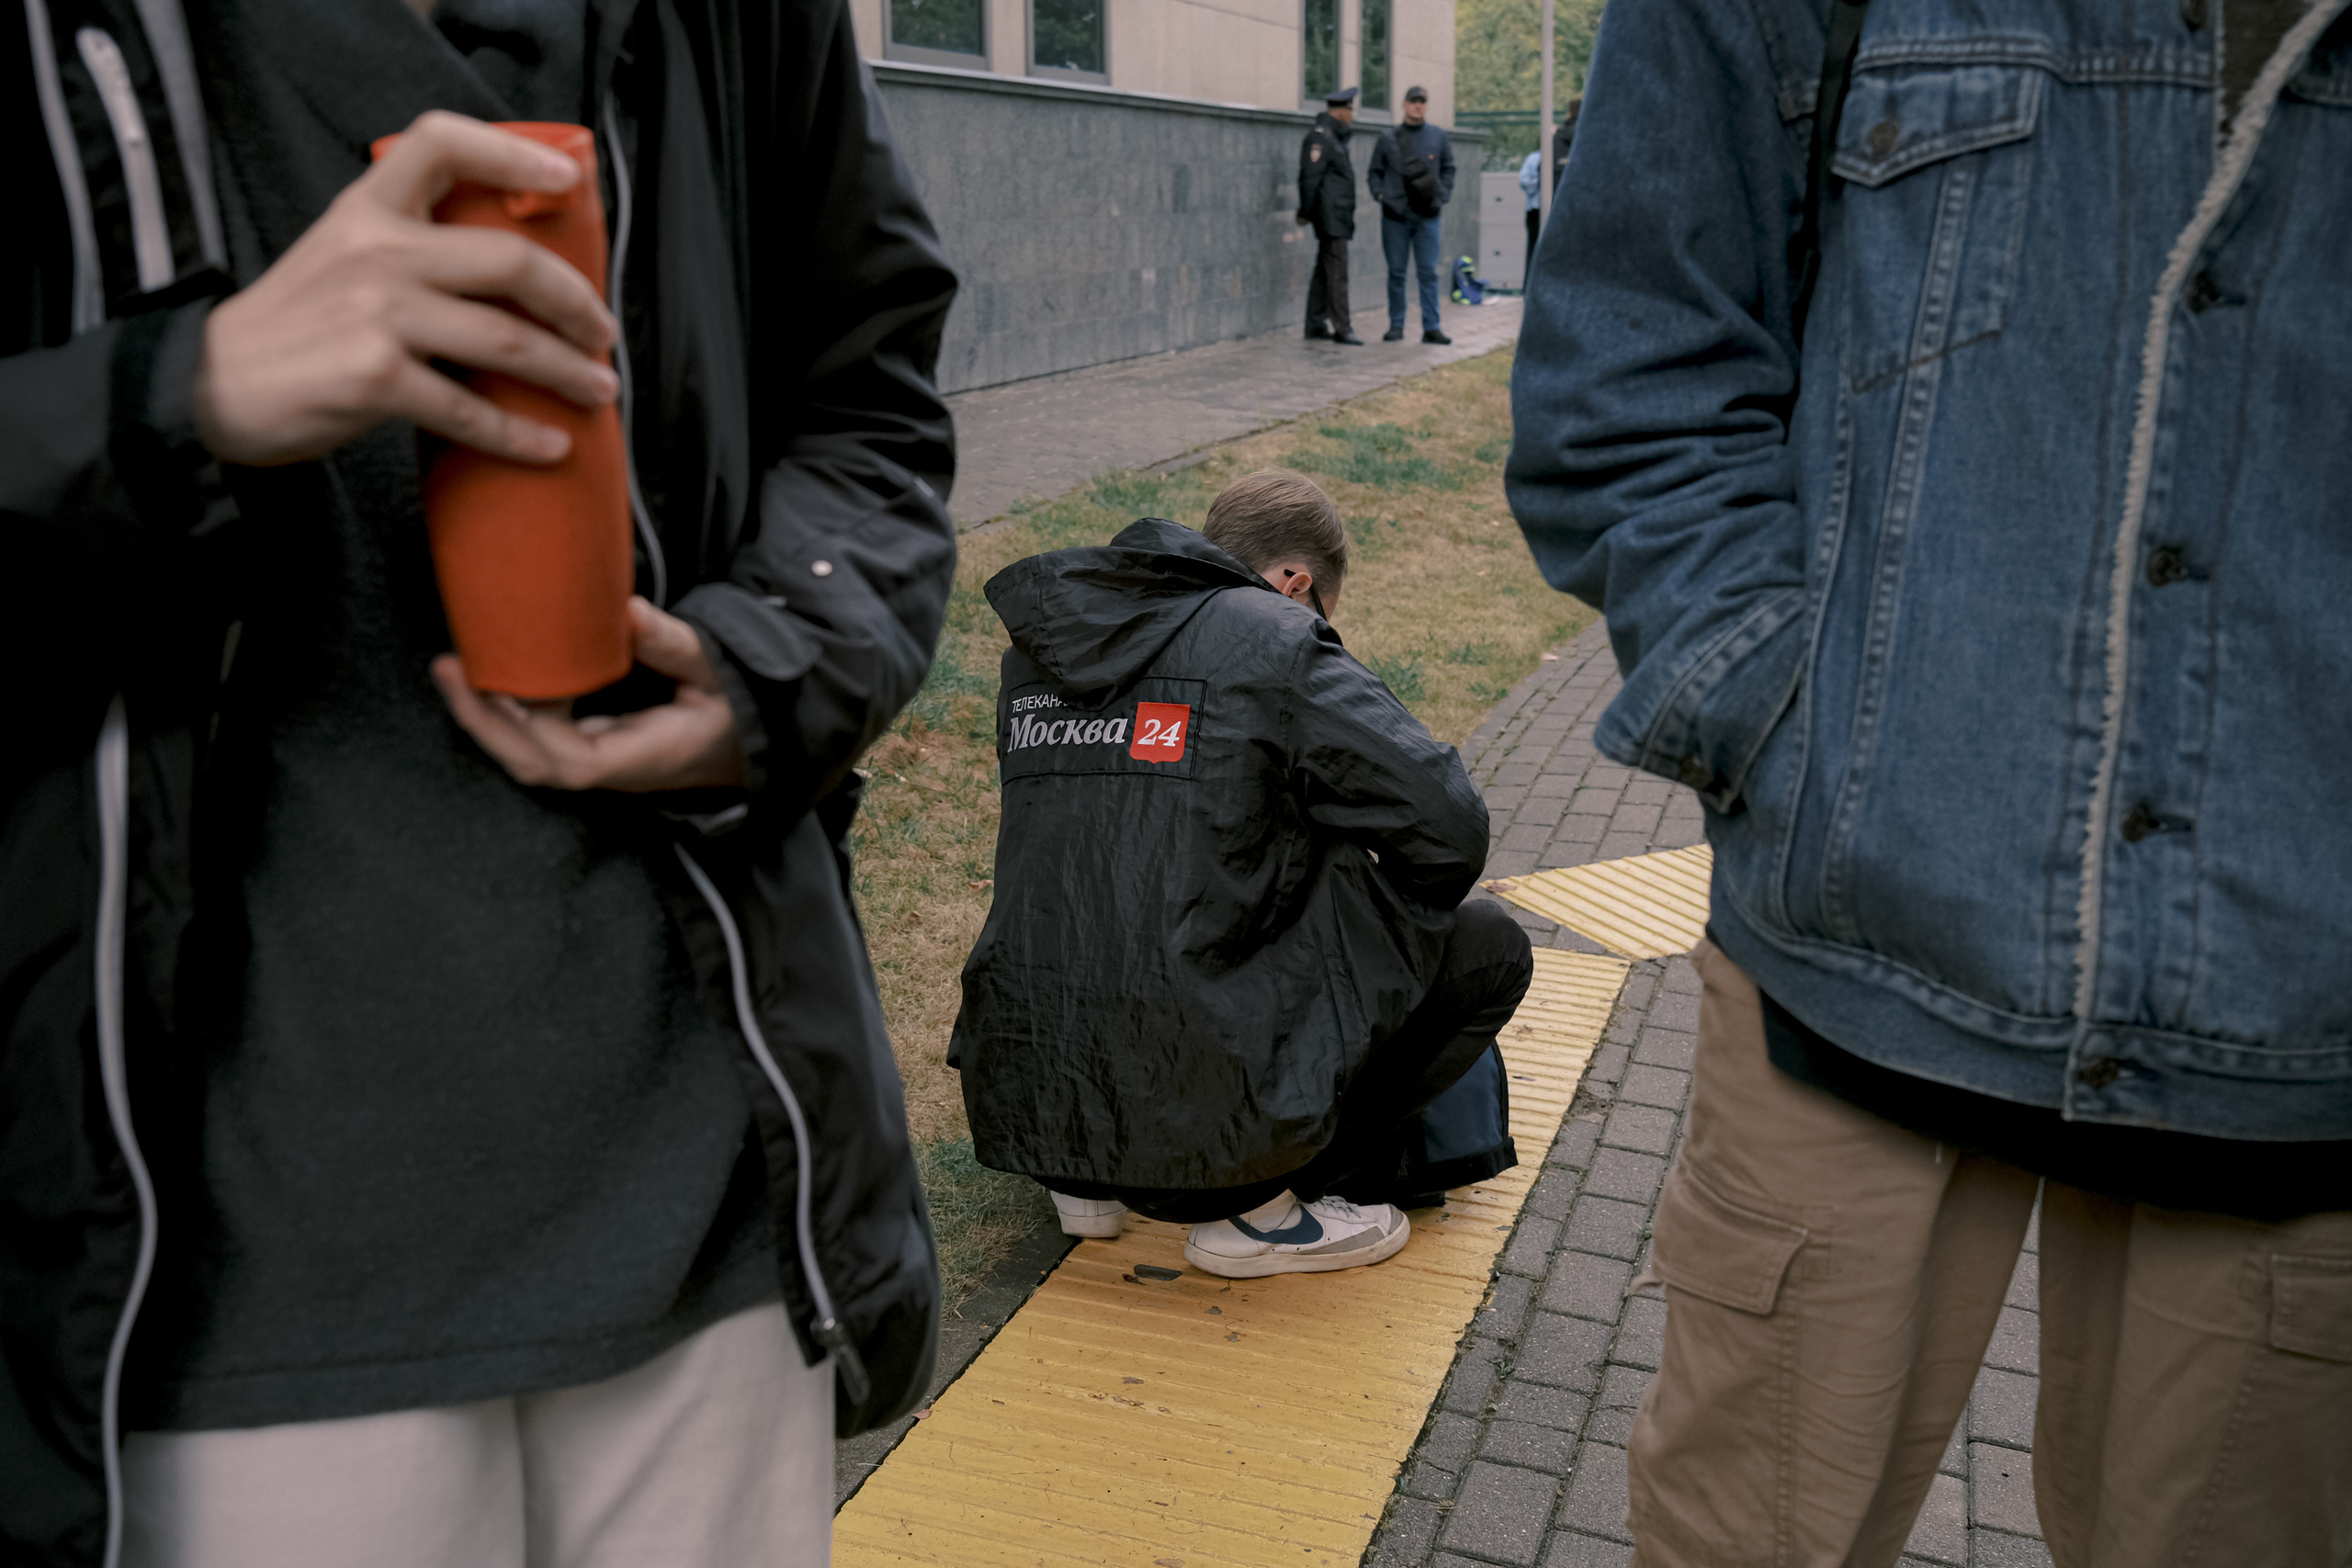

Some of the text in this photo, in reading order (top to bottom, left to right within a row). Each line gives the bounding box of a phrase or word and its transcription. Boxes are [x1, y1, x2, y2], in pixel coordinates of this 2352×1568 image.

[1012, 694, 1069, 713] ТЕЛЕКАН
[1007, 714, 1182, 753] Москва 24
